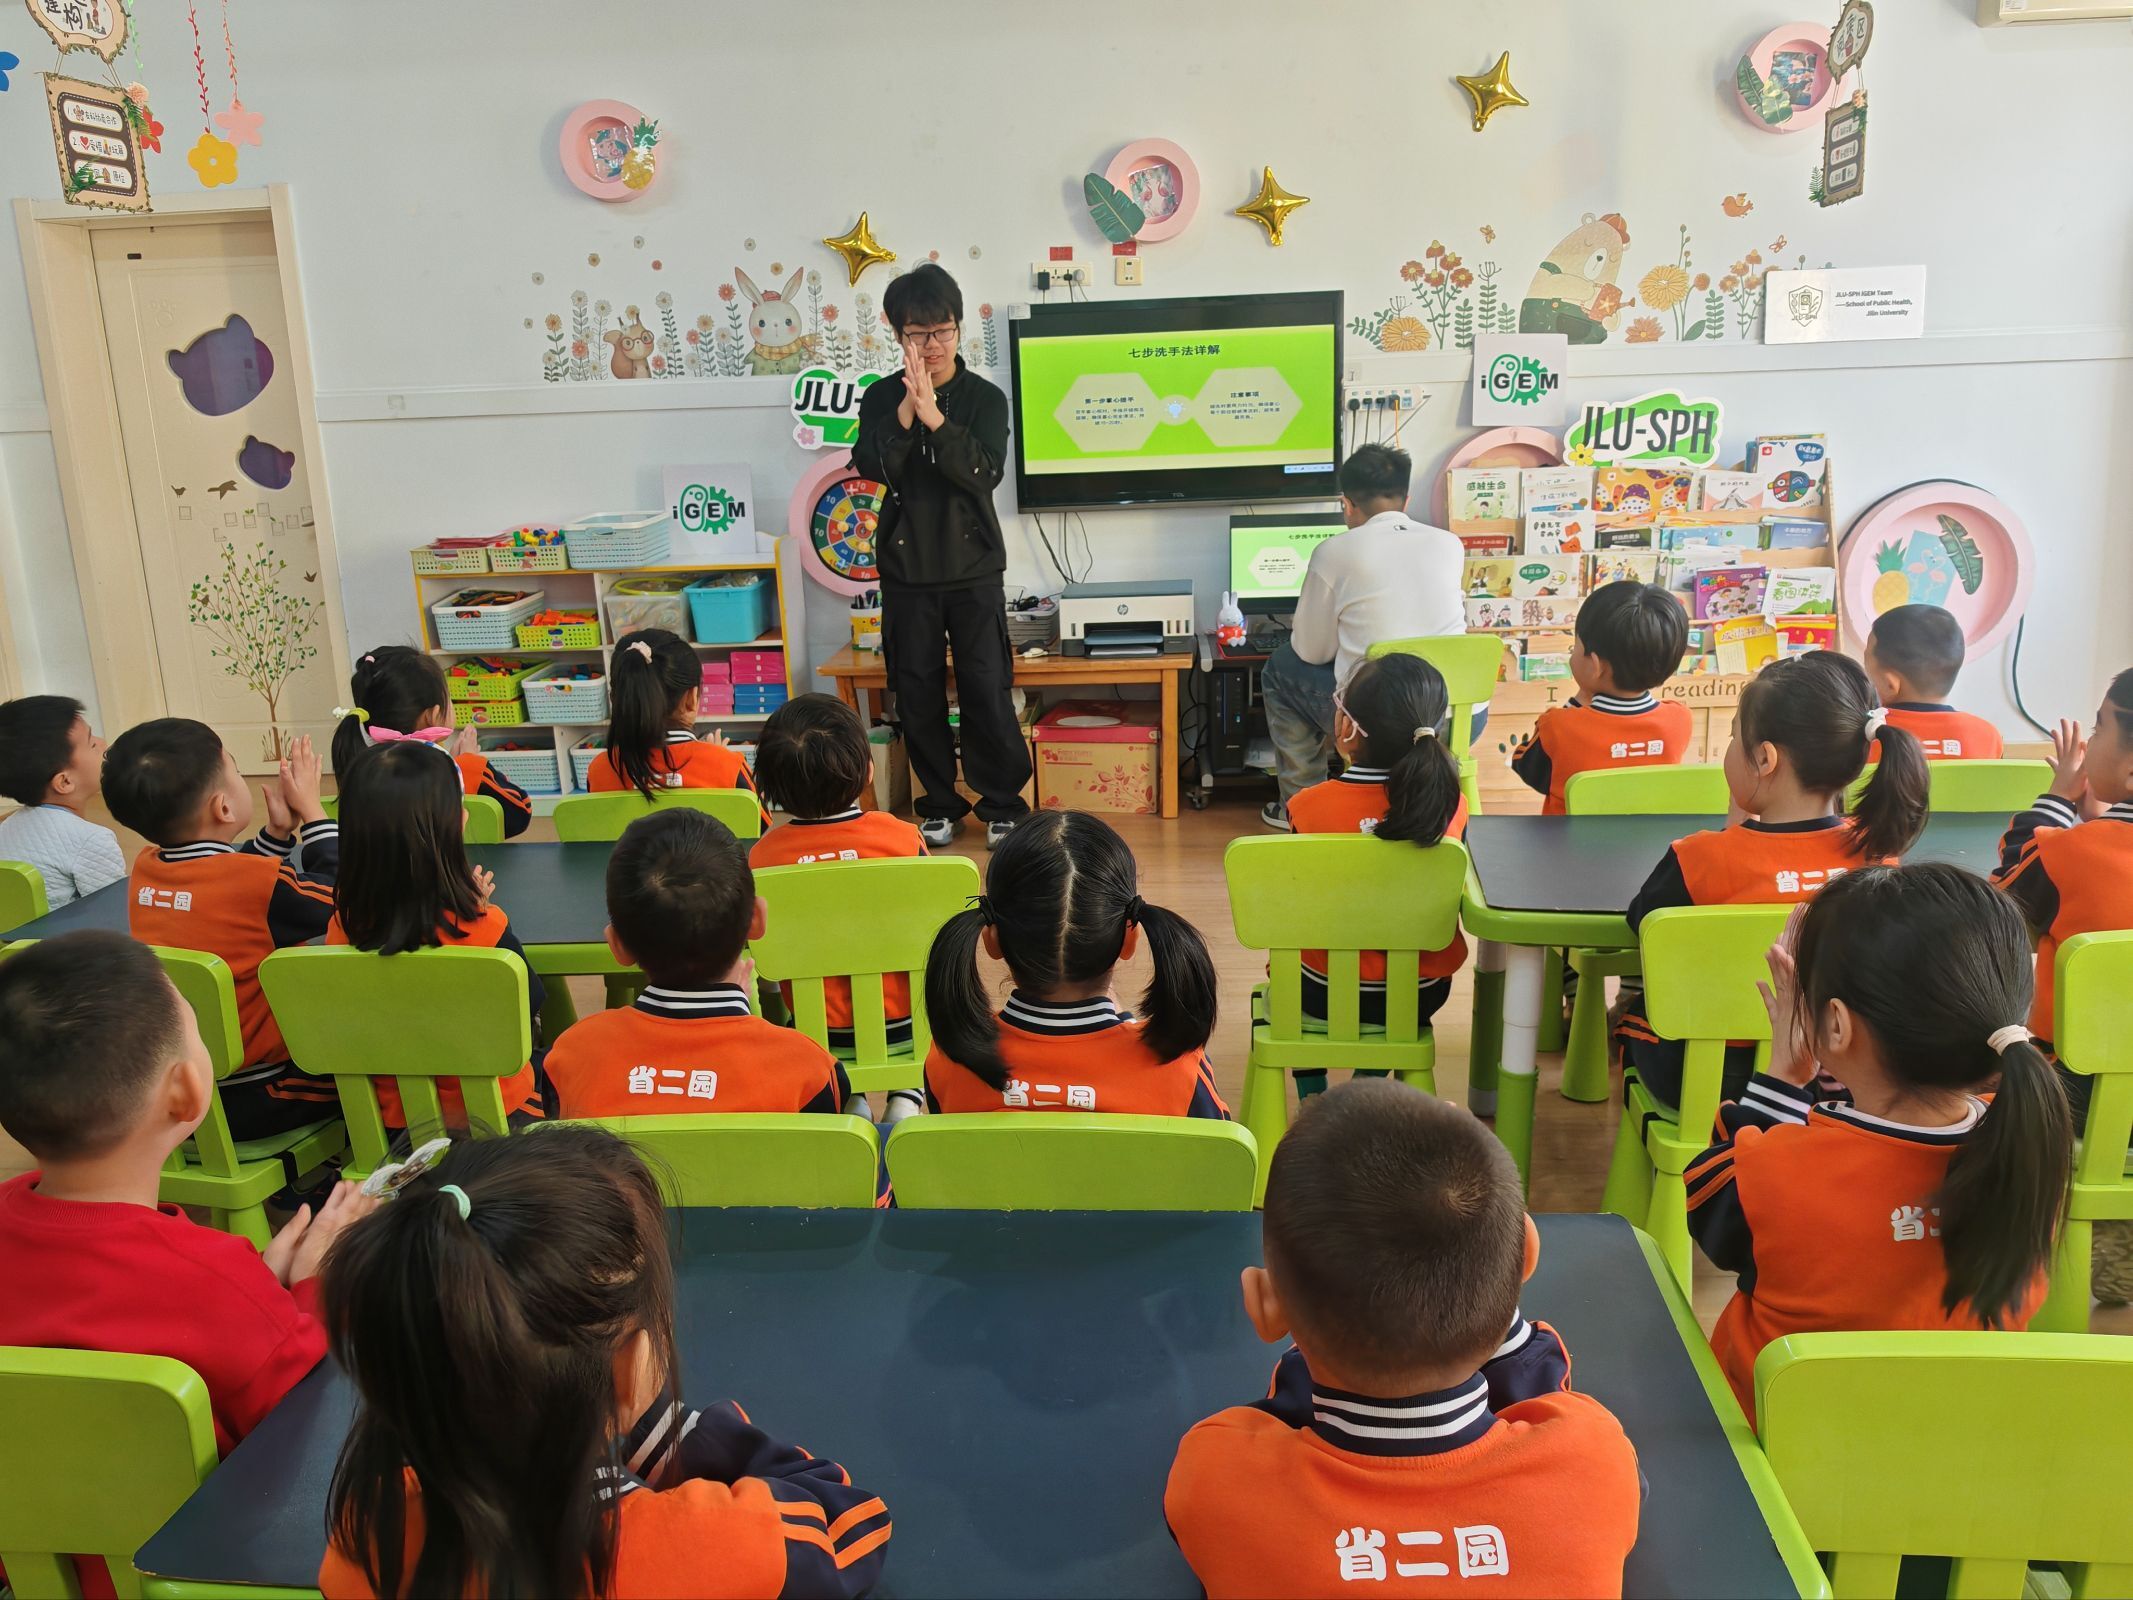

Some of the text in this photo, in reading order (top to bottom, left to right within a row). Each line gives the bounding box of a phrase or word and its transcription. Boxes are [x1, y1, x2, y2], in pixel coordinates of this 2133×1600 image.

[1128, 344, 1221, 358] 七步洗手法详解
[1481, 373, 1559, 389] iGEM
[794, 380, 862, 414] JLU-
[1582, 405, 1715, 455] JLU-SPH
[673, 501, 746, 520] iGEM
[826, 495, 836, 504] 10
[815, 527, 825, 537] 10
[1610, 740, 1664, 759] 省二园
[1776, 867, 1849, 893] 省二
[138, 886, 193, 912] 省二园
[628, 1065, 718, 1100] 省二园
[1002, 1079, 1096, 1111] 省二园
[1335, 1526, 1511, 1583] 省二园
